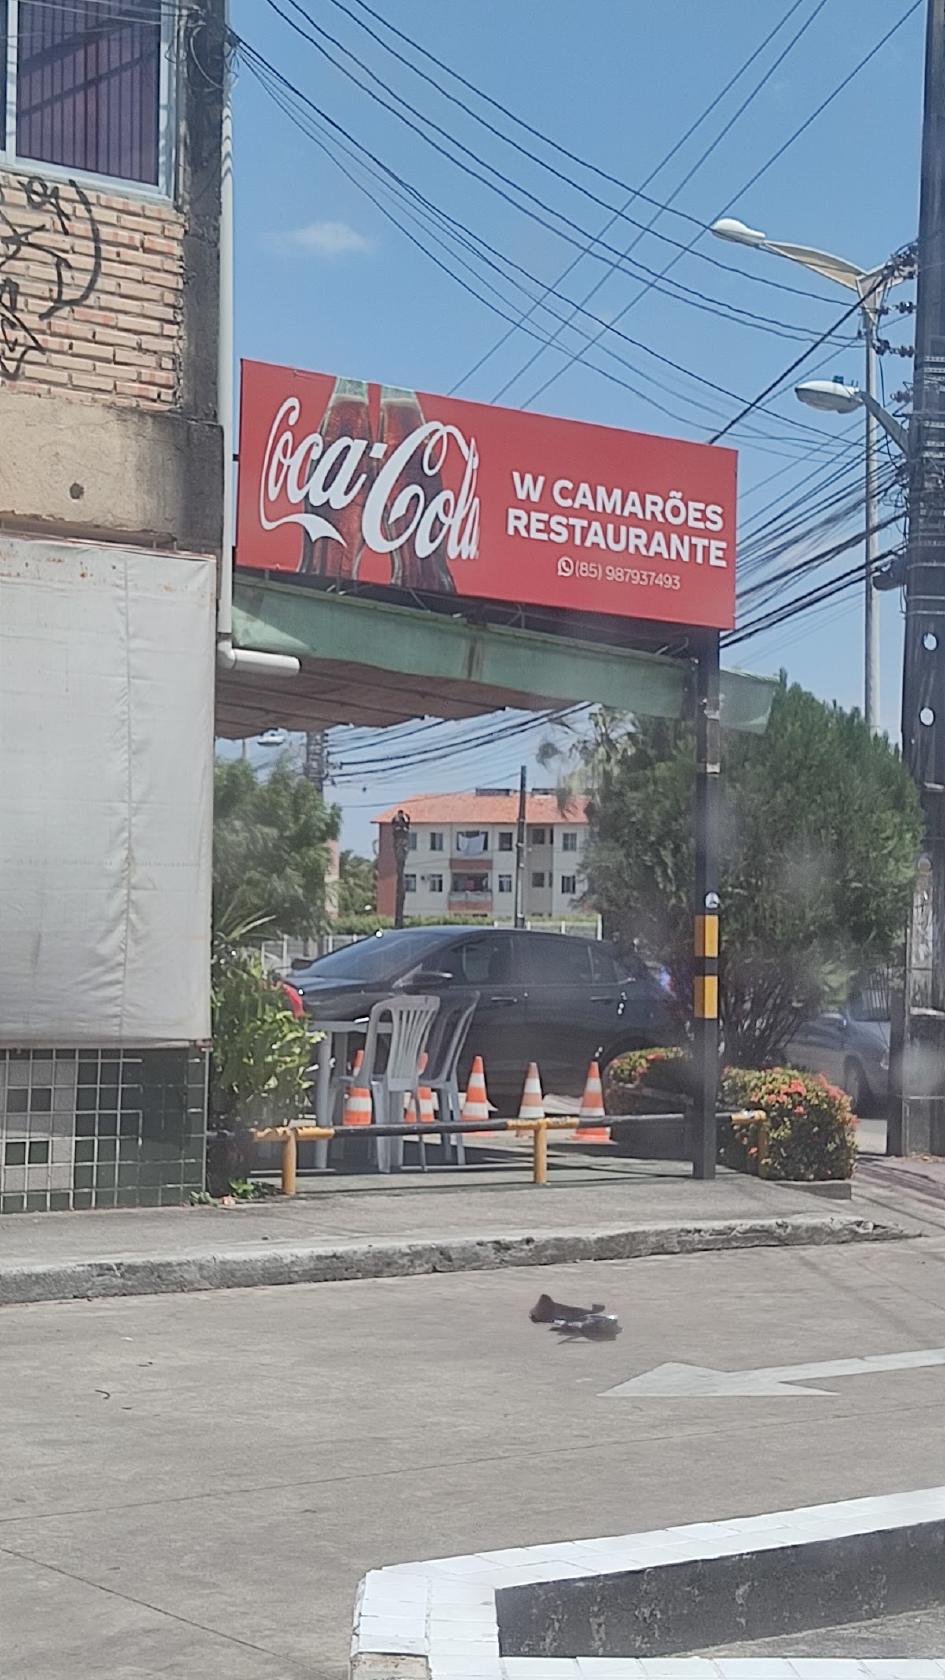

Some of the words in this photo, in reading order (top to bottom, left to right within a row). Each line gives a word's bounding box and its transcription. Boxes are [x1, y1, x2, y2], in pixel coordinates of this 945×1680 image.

[512, 471, 545, 502] W
[552, 479, 724, 532] CAMARÕES
[507, 507, 728, 568] RESTAURANTE
[575, 560, 602, 579] (85)
[605, 565, 681, 590] 987937493
